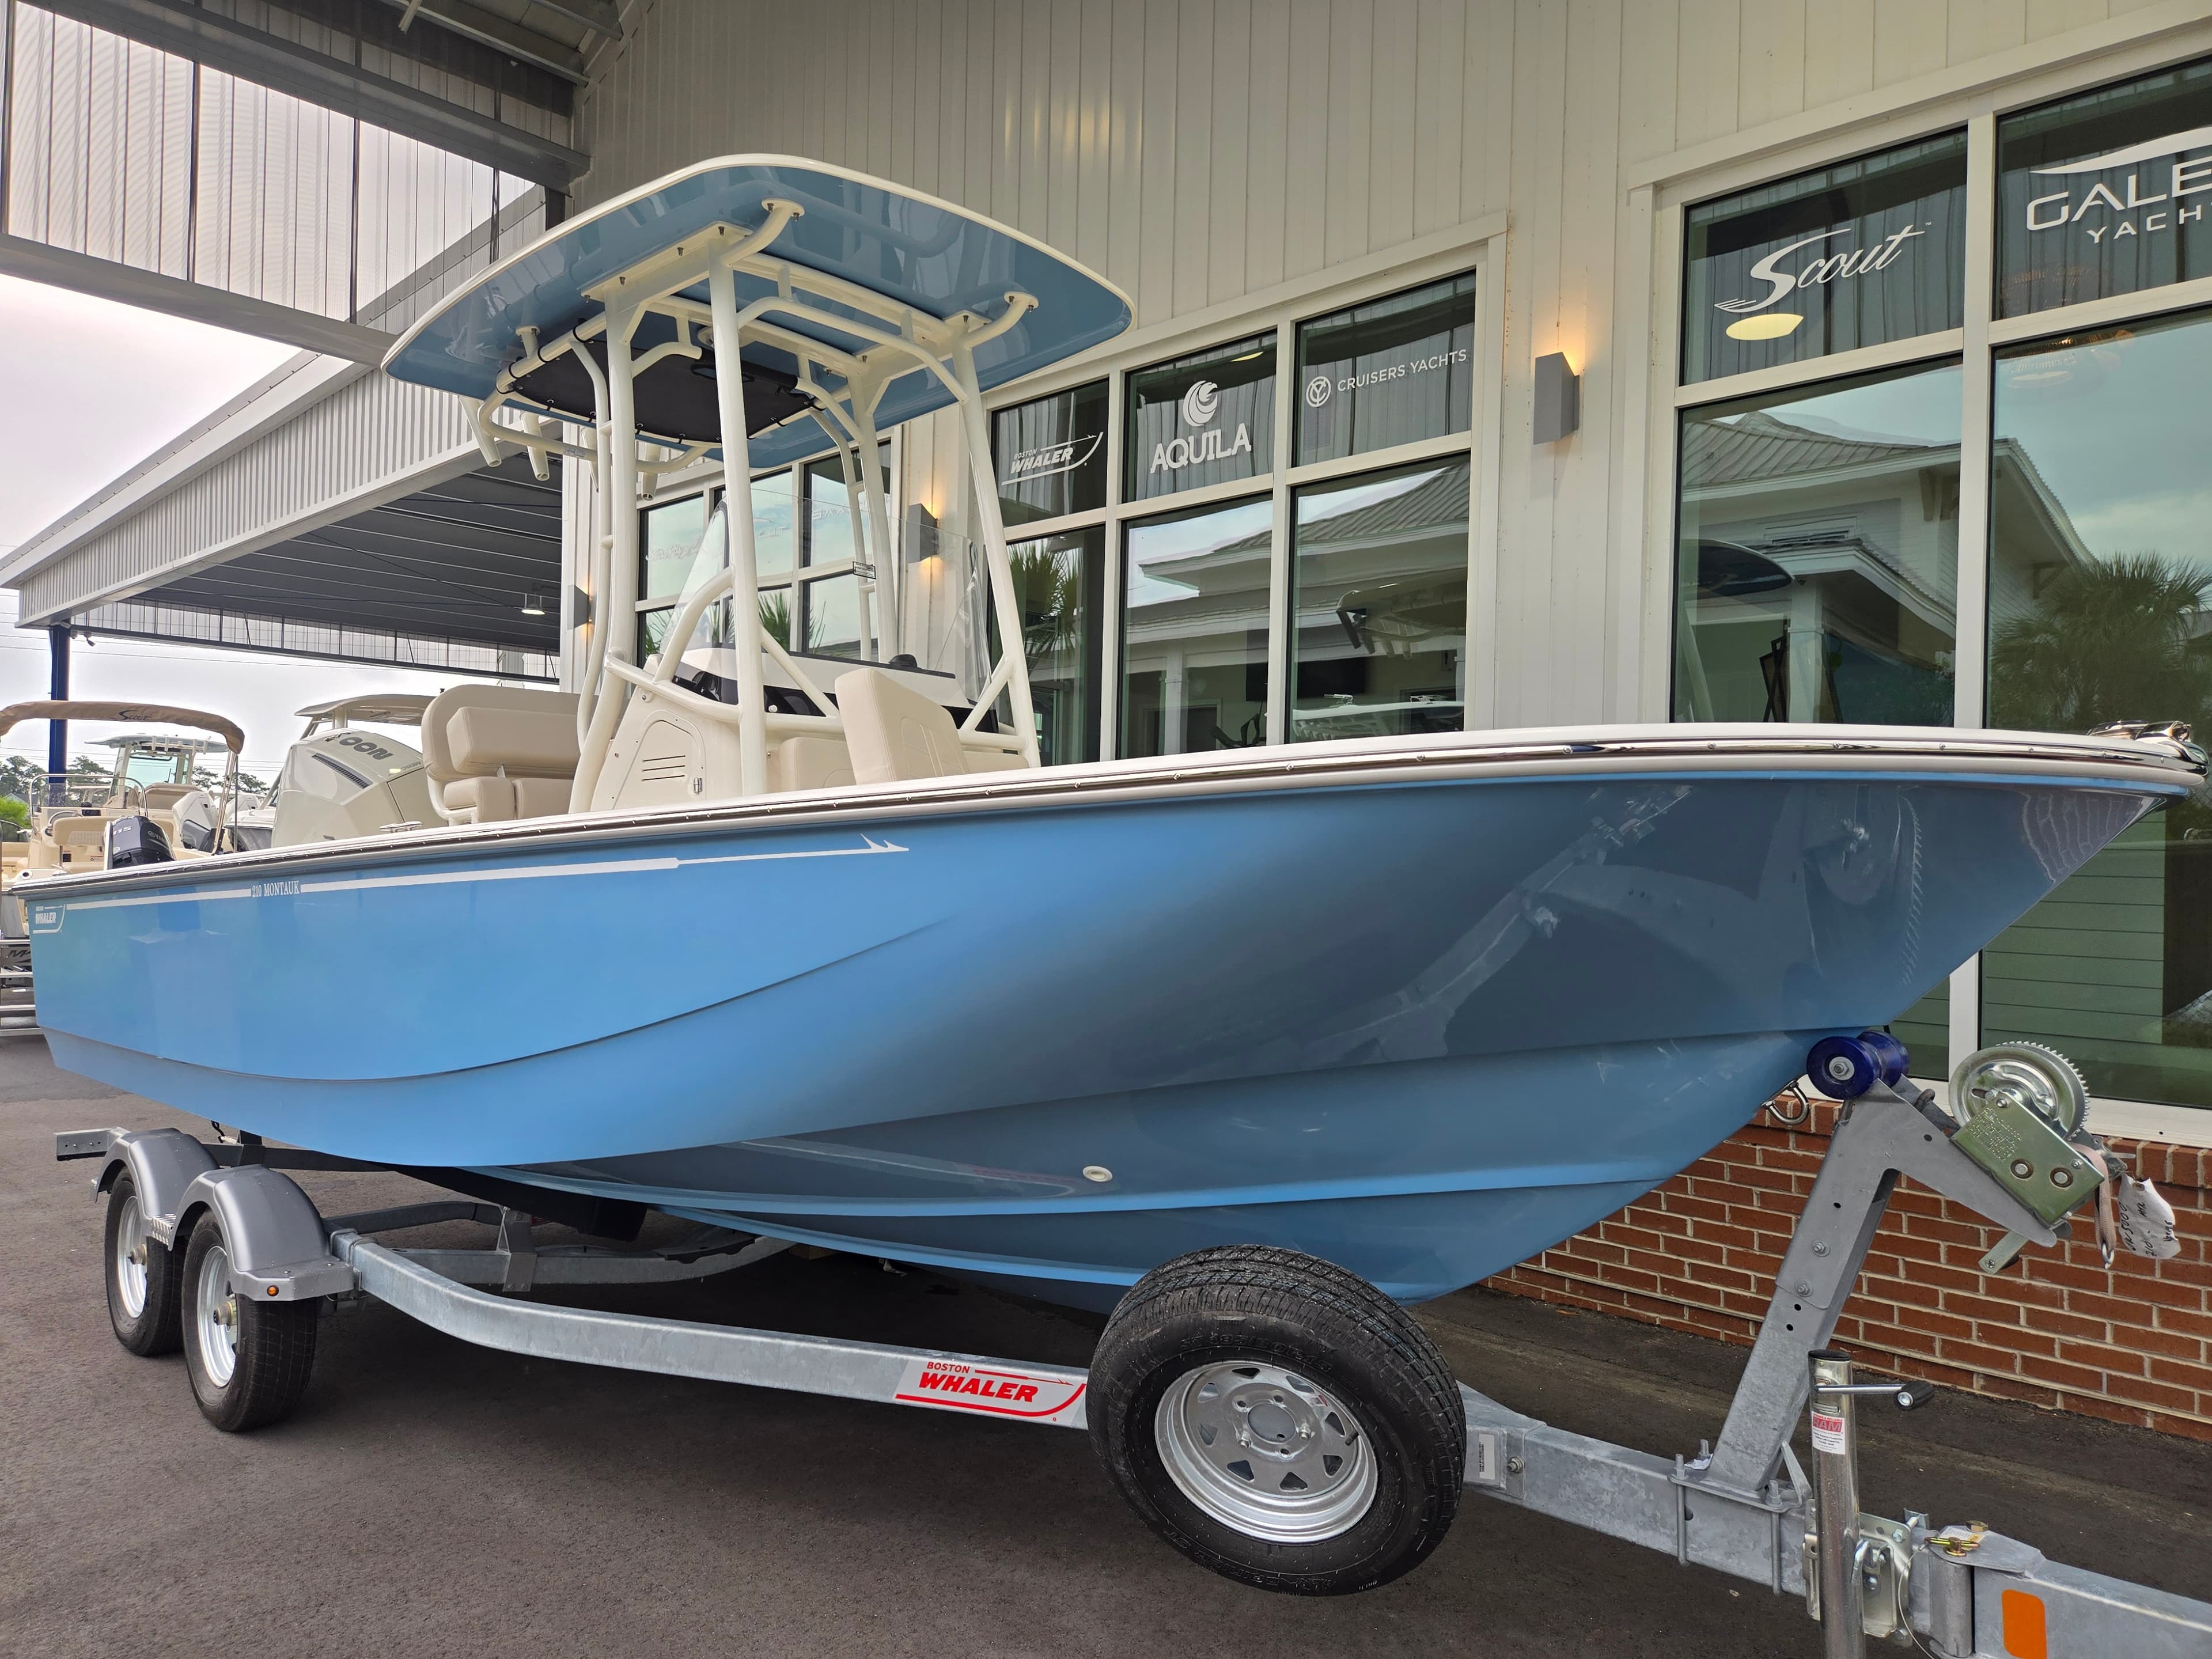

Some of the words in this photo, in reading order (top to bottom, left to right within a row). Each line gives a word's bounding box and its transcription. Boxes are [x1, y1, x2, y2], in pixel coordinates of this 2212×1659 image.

[2086, 202, 2212, 244] YACH
[1714, 225, 1925, 313] Scout
[1337, 364, 1406, 392] CRUISERS
[1410, 349, 1467, 374] YACHTS
[1010, 447, 1074, 474] WHALER
[1014, 448, 1037, 460] BOSTON
[1150, 422, 1252, 474] AQUILA
[252, 885, 262, 898] 210
[264, 880, 300, 897] MONTAUK
[926, 1361, 971, 1374] BOSTON
[918, 1372, 1039, 1403] WHALER
[1813, 1418, 1842, 1431] RAM
